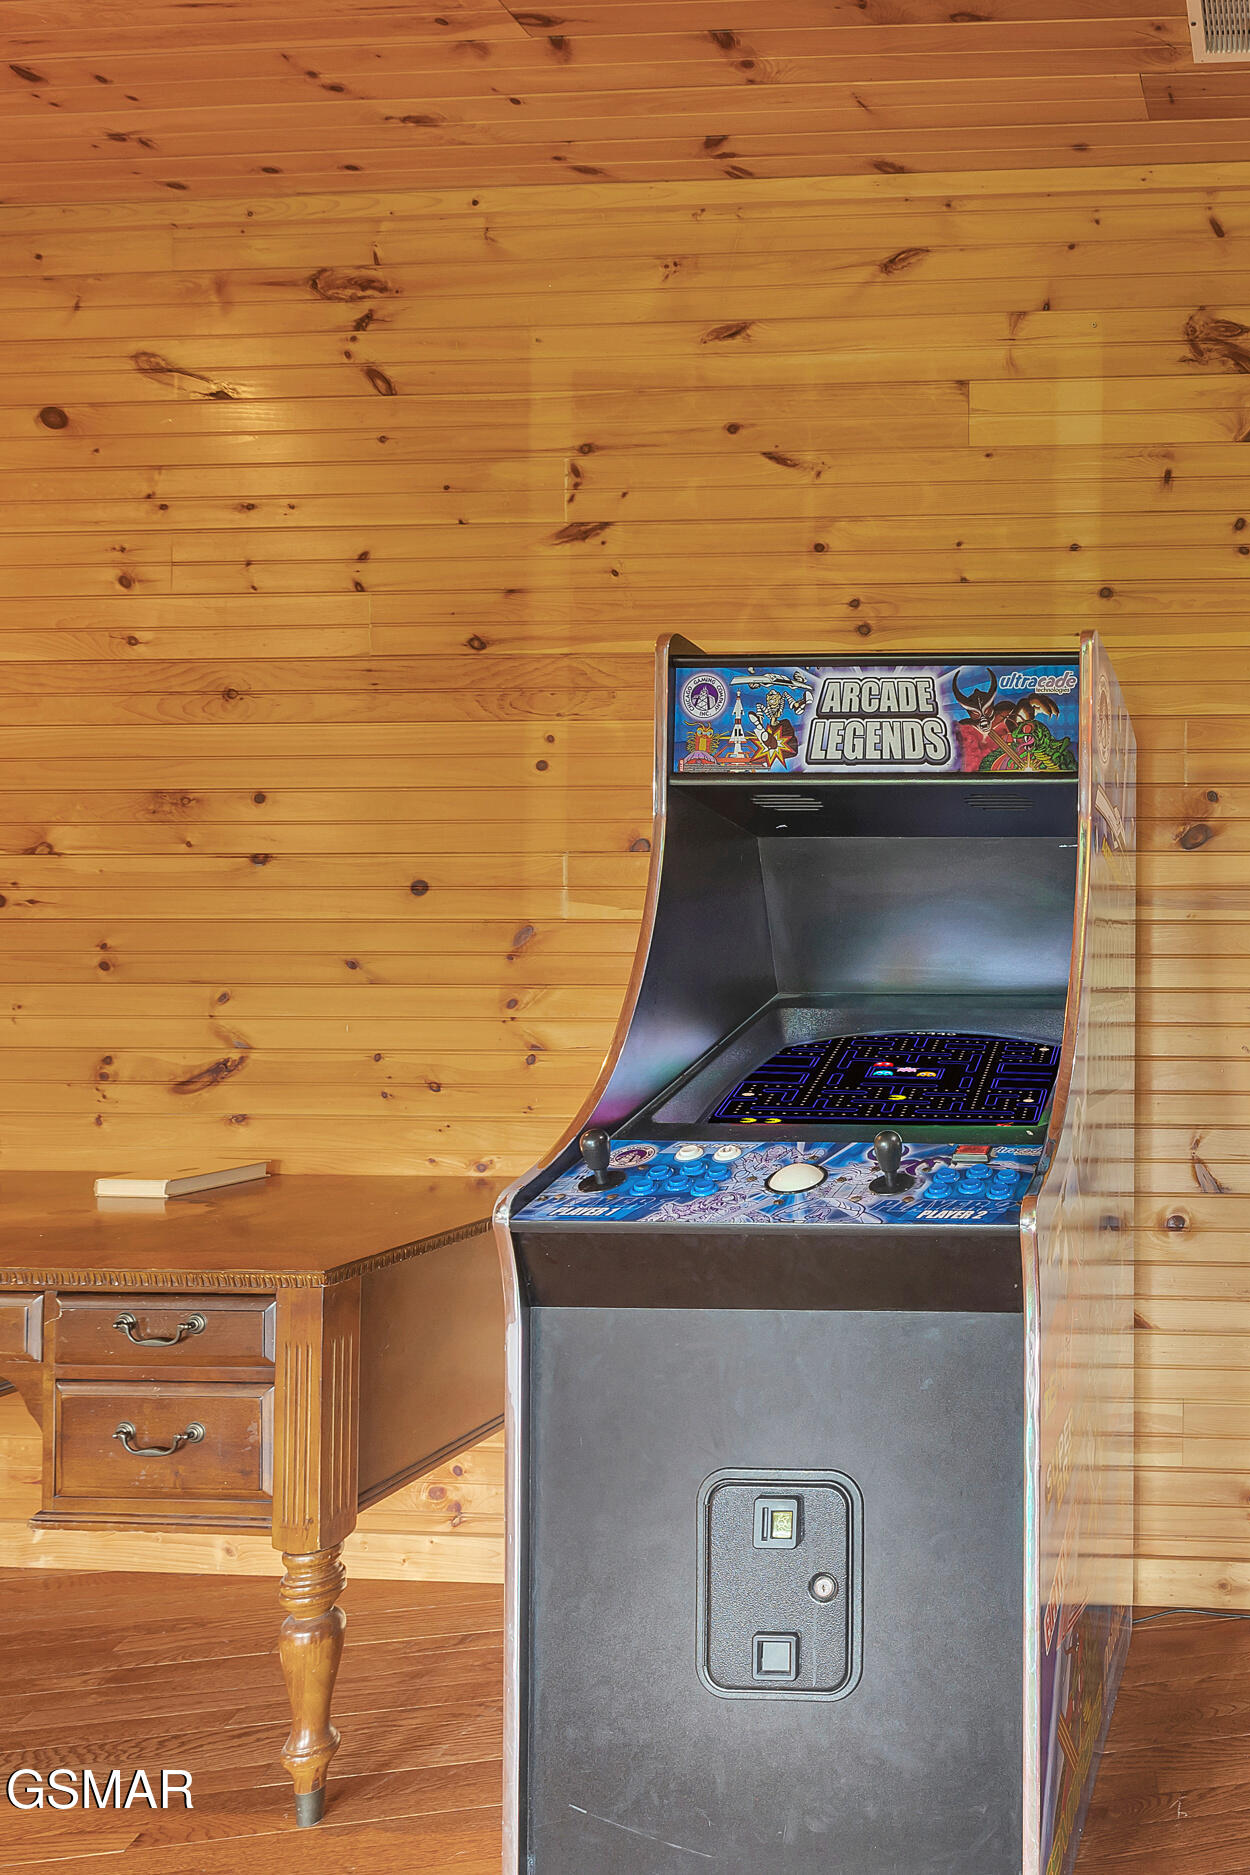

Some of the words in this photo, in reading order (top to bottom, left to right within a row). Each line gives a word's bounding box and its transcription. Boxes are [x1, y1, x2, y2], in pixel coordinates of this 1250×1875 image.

[694, 677, 716, 685] GAMING
[999, 671, 1078, 689] ultracade
[1036, 687, 1071, 695] technologies
[820, 680, 935, 713] ARCADE
[810, 719, 947, 761] LEGENDS
[549, 1207, 609, 1216] PLAYER
[606, 1207, 621, 1216] 1
[916, 1210, 975, 1219] PLAYER
[975, 1210, 988, 1219] 2
